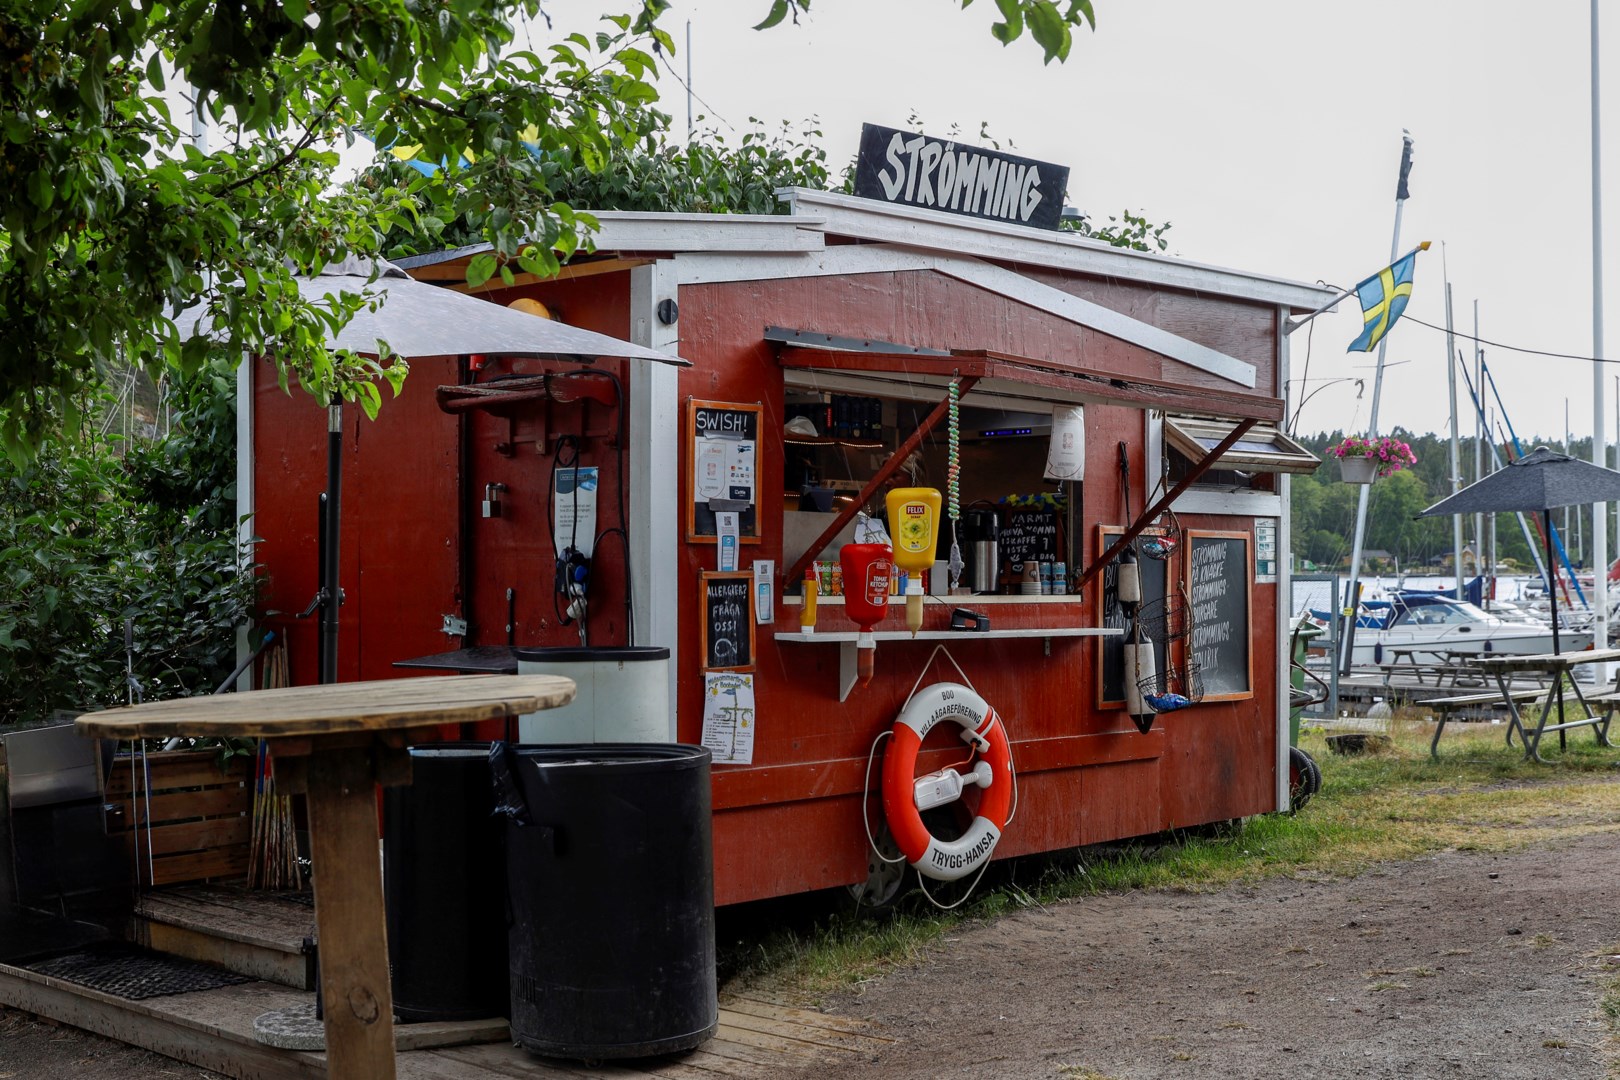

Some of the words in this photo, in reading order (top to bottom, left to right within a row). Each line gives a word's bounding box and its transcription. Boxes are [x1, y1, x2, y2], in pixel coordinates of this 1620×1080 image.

[878, 132, 1043, 222] STRÖMMING
[696, 410, 748, 432] SWISH!
[907, 505, 924, 514] FELIX
[1192, 541, 1228, 568] STRÖMMING
[870, 581, 889, 589] KETCHUP
[873, 575, 888, 583] TOMAT
[707, 583, 748, 599] ALLERGIER?
[712, 600, 741, 618] FRÅGA
[1193, 599, 1219, 623] BURGARE
[714, 620, 737, 638] OSS!
[941, 689, 955, 701] BOO
[919, 702, 982, 736] VILLAÄGAREFÖRENING
[932, 831, 995, 869] TRYGG-HANSA
